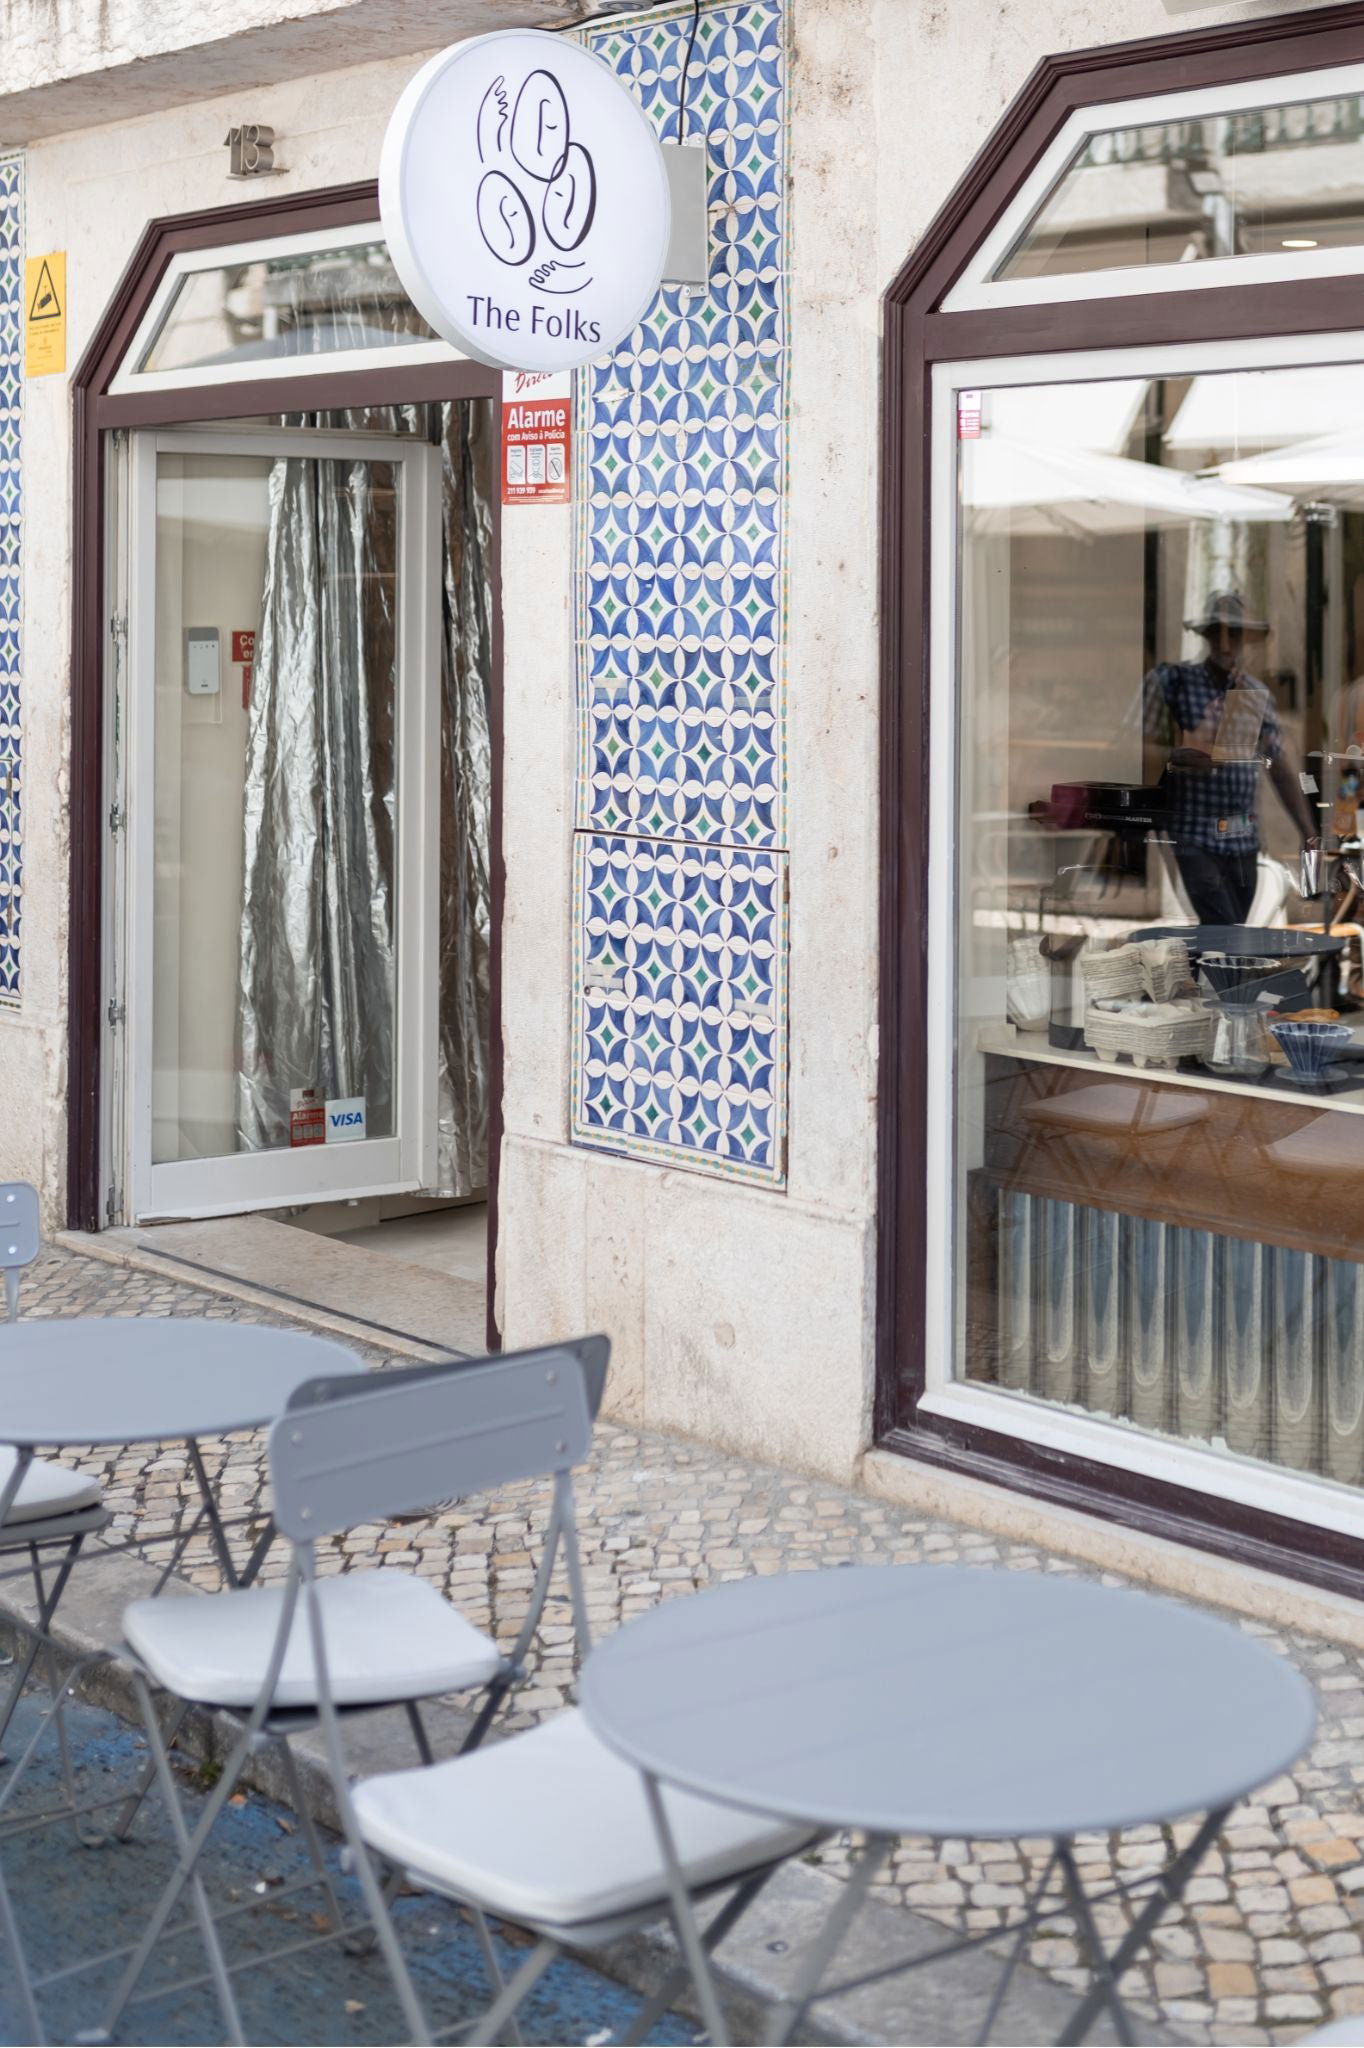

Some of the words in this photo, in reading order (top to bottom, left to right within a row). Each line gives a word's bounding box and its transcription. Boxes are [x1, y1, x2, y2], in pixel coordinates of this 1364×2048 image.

[223, 125, 275, 176] 13
[467, 295, 520, 332] The
[531, 305, 601, 343] Folks
[507, 406, 565, 429] Alarme
[507, 433, 520, 441] com
[521, 431, 538, 440] Aviso
[329, 1112, 363, 1127] VISA
